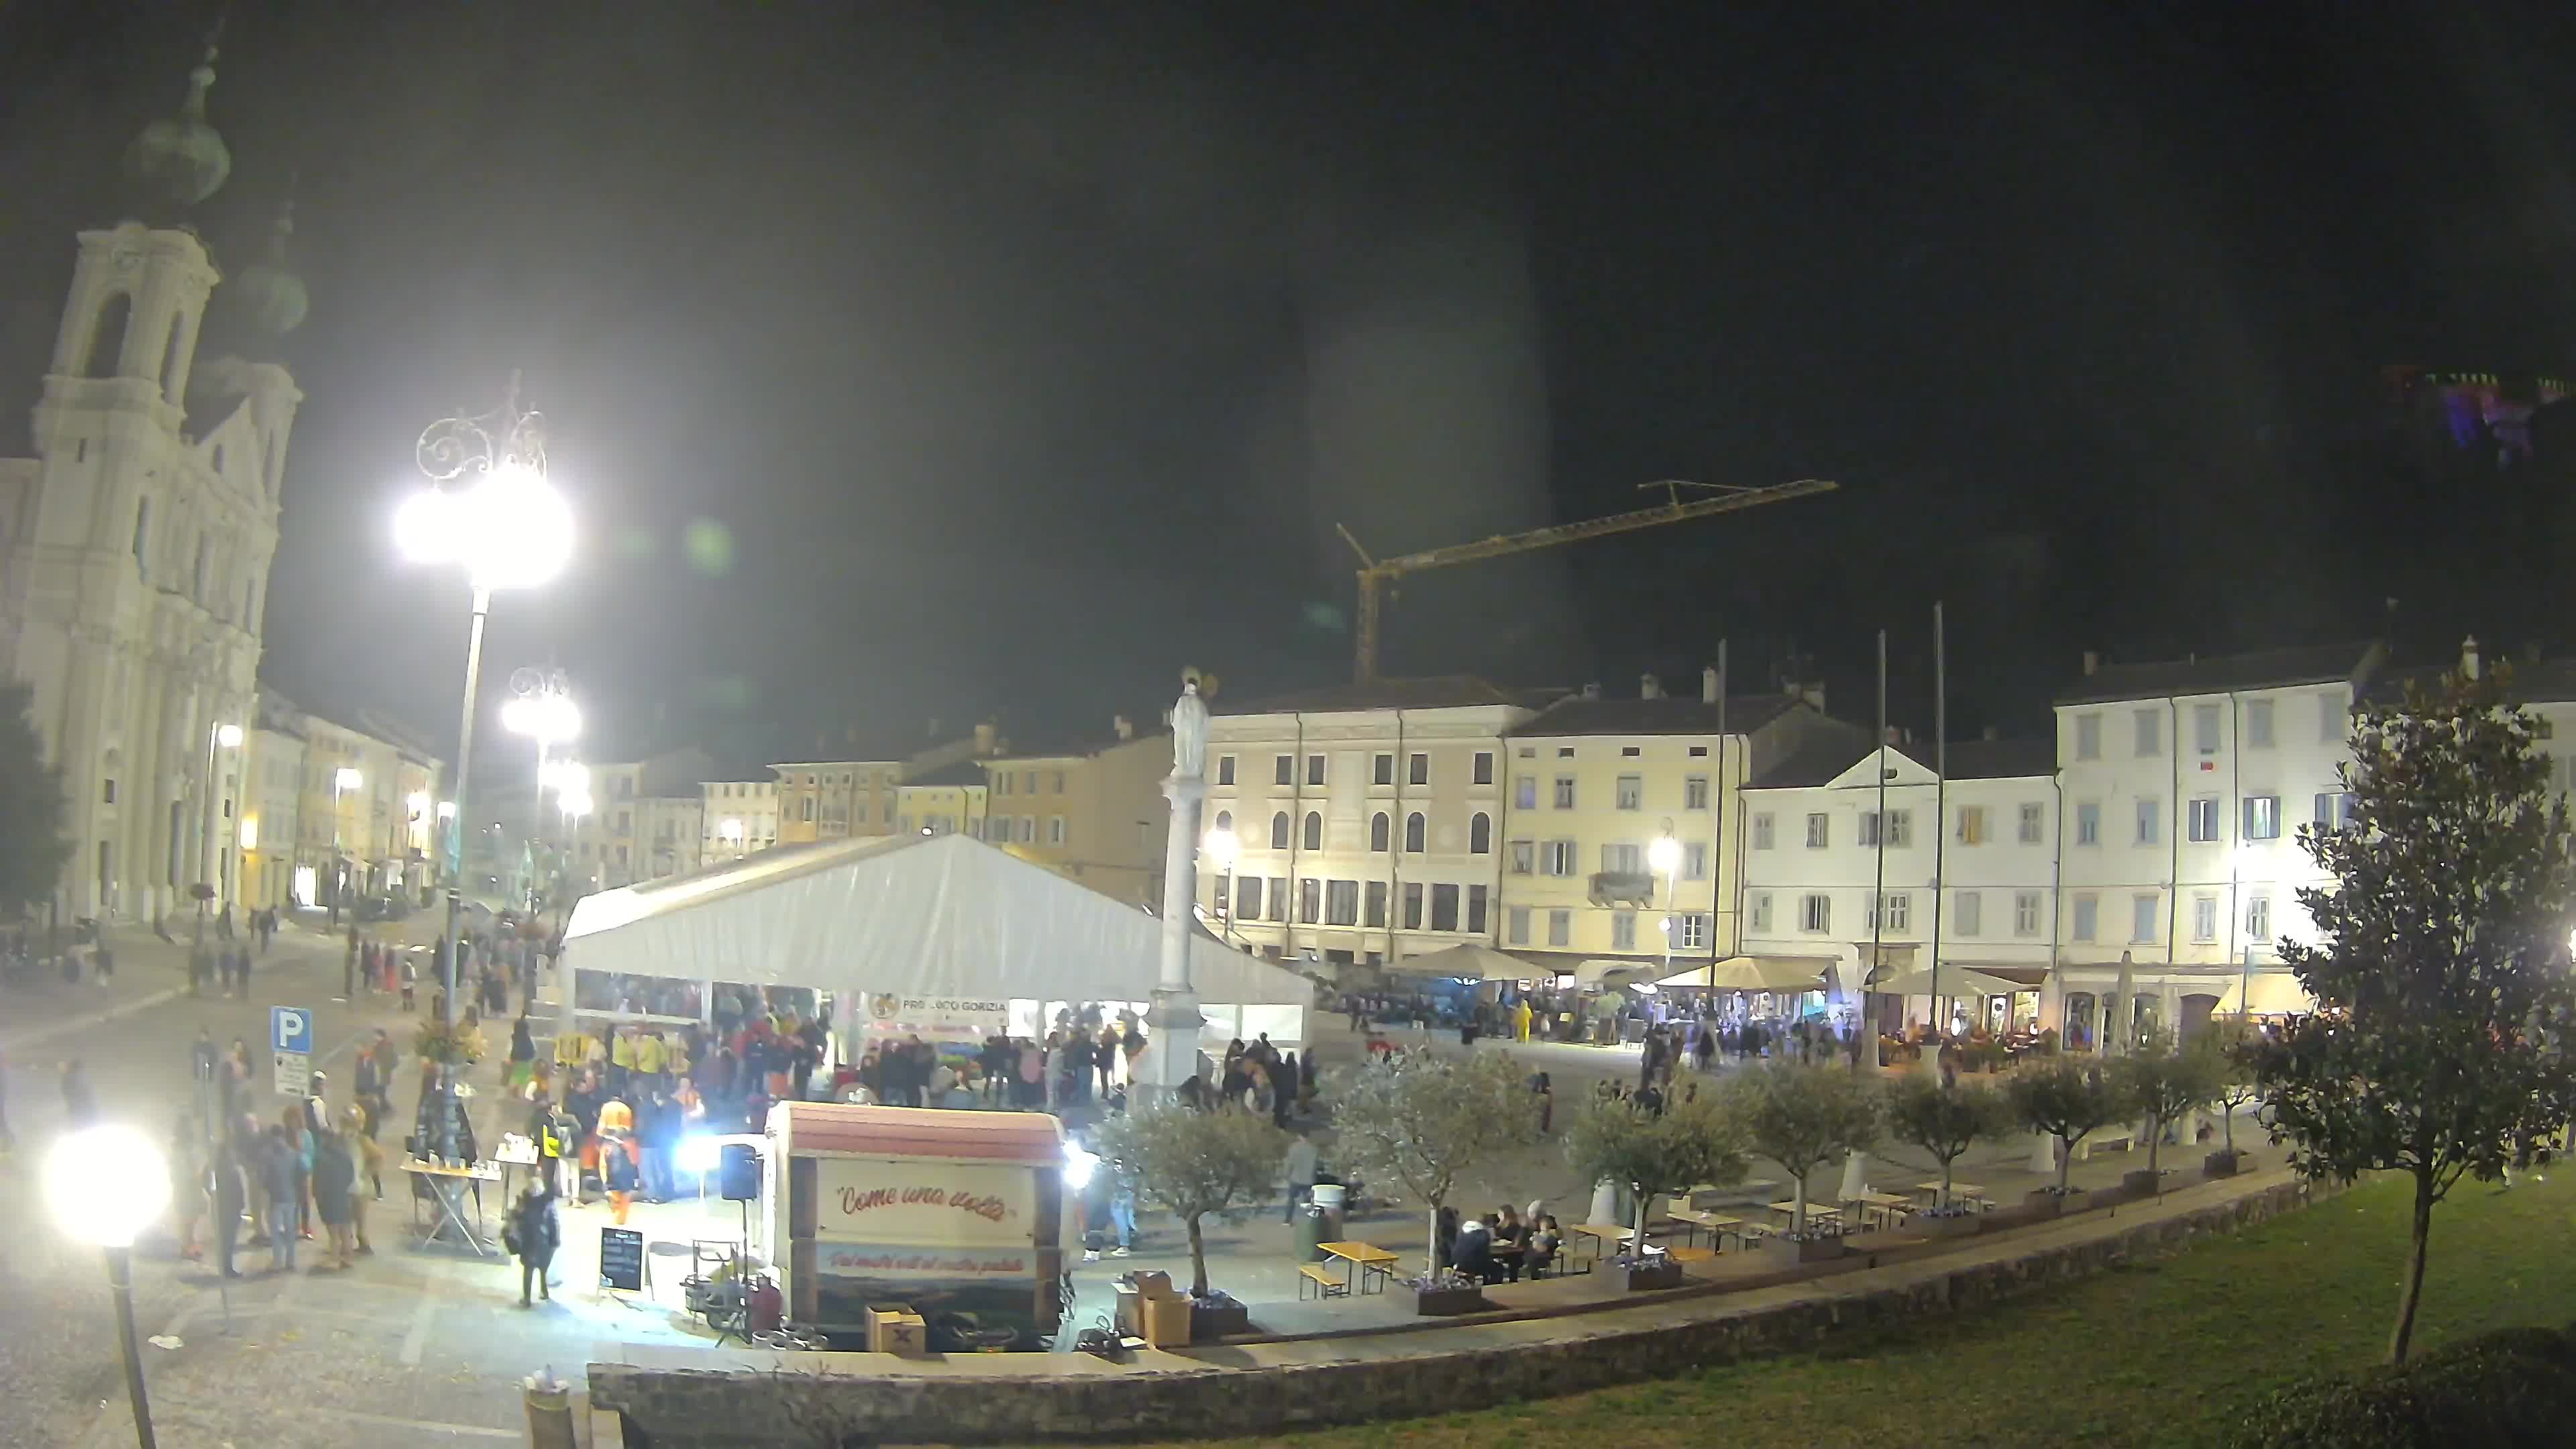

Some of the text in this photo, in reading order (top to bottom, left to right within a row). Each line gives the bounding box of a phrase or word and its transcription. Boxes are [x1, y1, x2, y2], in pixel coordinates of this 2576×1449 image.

[903, 1000, 925, 1009] PRO
[961, 1002, 1006, 1011] GORIZIA
[279, 1012, 303, 1047] P
